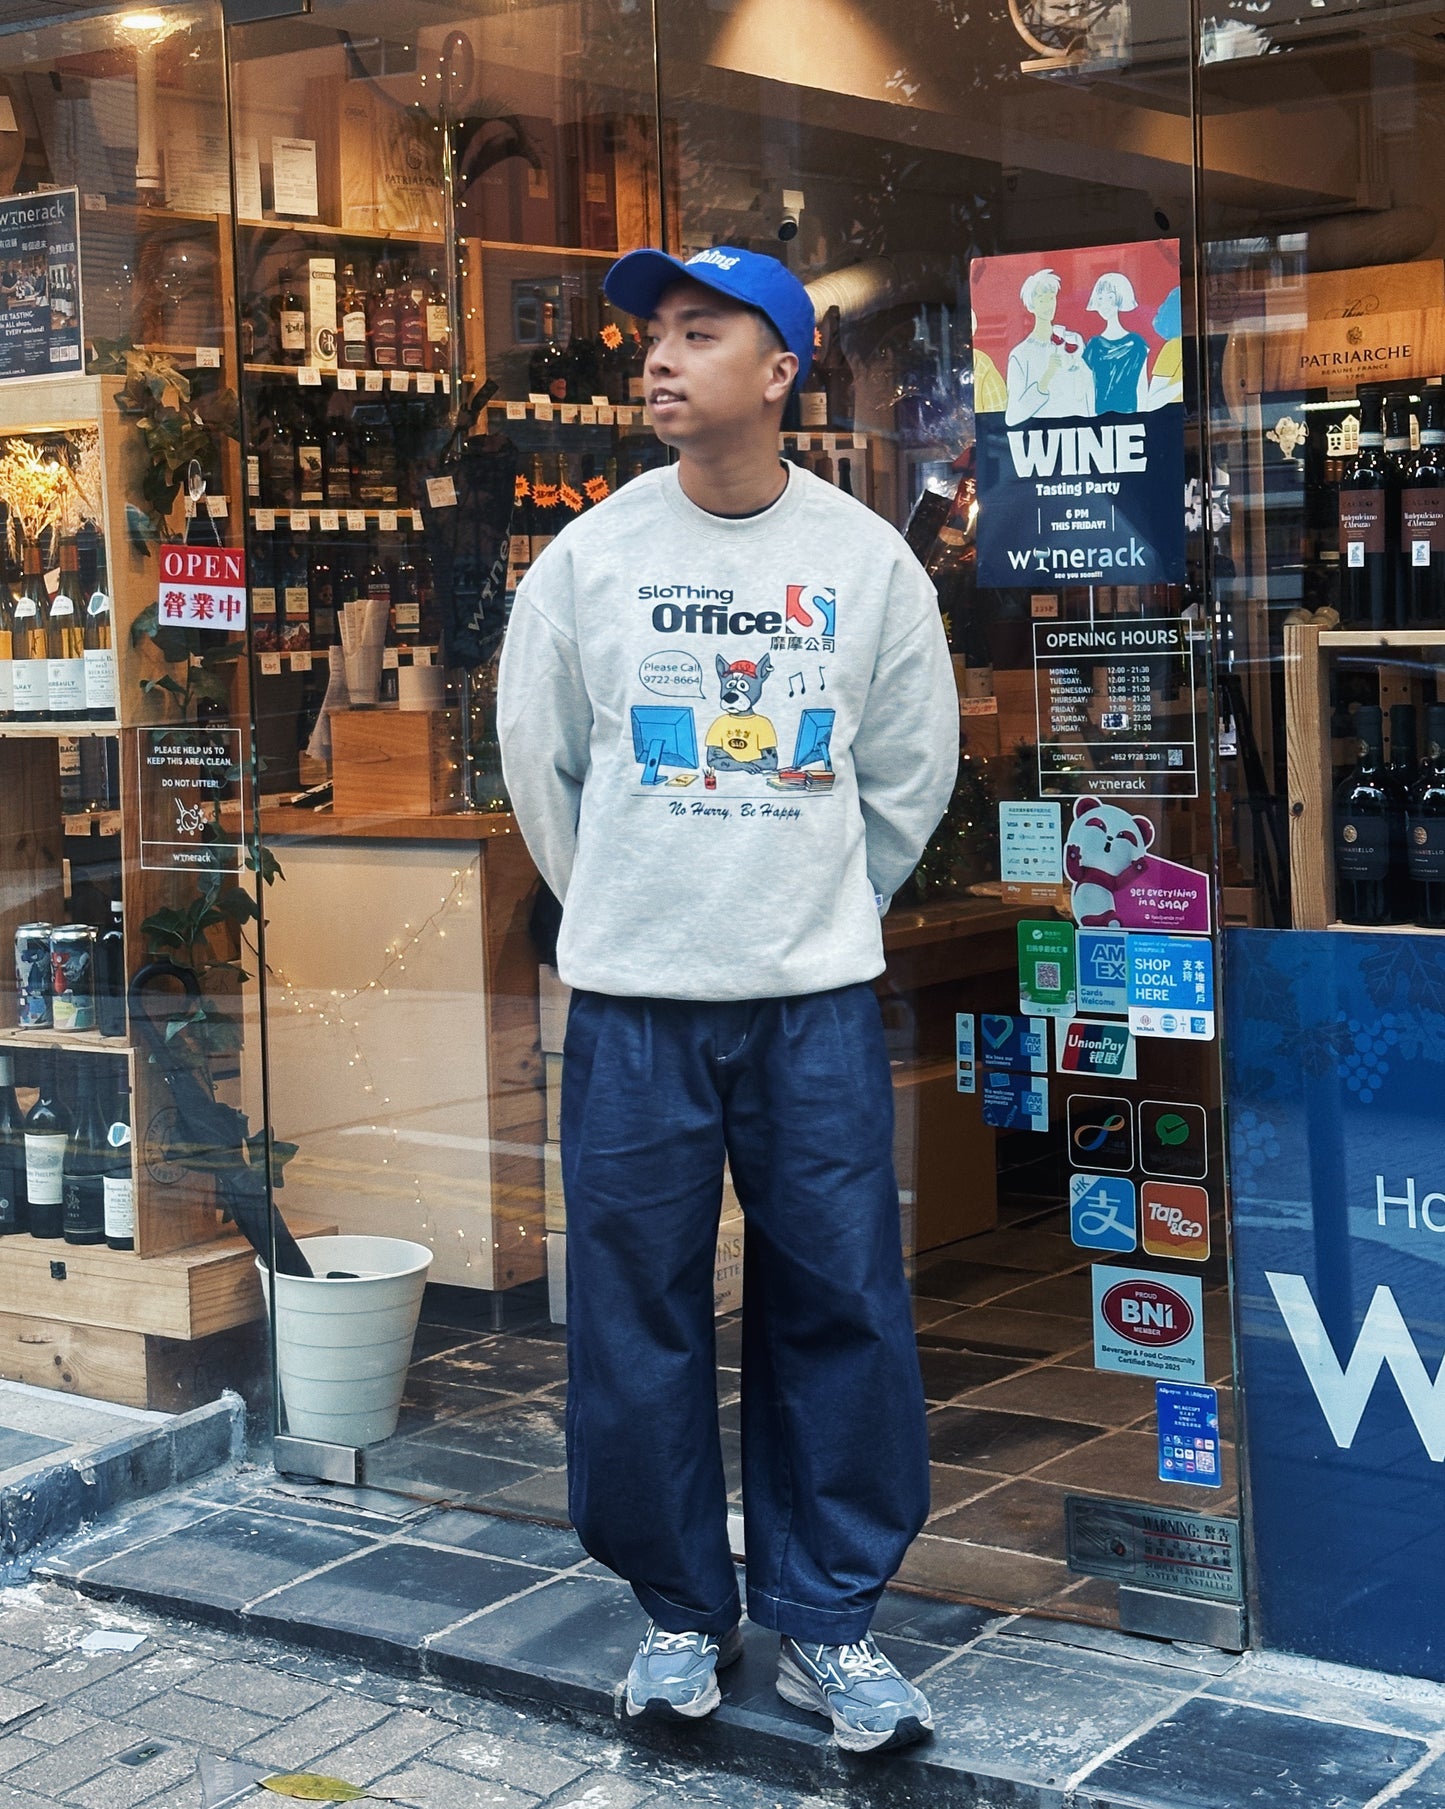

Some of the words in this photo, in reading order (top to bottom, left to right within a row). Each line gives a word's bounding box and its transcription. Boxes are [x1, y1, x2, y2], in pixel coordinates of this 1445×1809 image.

[1300, 345, 1412, 369] PATRIARCHE
[1357, 363, 1389, 372] FRANCE
[1007, 424, 1148, 478] WINE
[1036, 482, 1082, 496] Tasting
[1085, 481, 1120, 495] Party
[1066, 509, 1072, 519] 6
[1074, 508, 1089, 518] PM
[1051, 522, 1070, 531] THIS
[1072, 520, 1106, 530] FRIDAY!
[1007, 537, 1146, 573] winerack
[165, 553, 242, 579] OPEN
[1067, 572, 1079, 580] you
[638, 585, 734, 604] SloThing
[164, 591, 241, 622] 營業中
[651, 603, 782, 636] Office
[1046, 632, 1116, 648] OPENING
[1121, 629, 1178, 645] HOURS
[644, 663, 678, 672] Please
[680, 663, 700, 672] Call
[644, 675, 700, 684] 9722-8664
[154, 747, 181, 755] PLEASE
[183, 747, 202, 755] HELP
[215, 747, 225, 755] TO
[147, 757, 166, 765] KEEP
[184, 758, 205, 766] AREA
[206, 757, 233, 766] CLEAN.
[162, 779, 173, 787] DO
[174, 779, 190, 787] NOT
[1088, 776, 1146, 790] winerack
[668, 801, 687, 816] No
[690, 801, 733, 820] Hurry,
[740, 803, 756, 817] Be
[173, 852, 211, 863] winerack
[1130, 888, 1145, 897] get
[1147, 888, 1197, 900] everything
[1138, 897, 1147, 906] in
[1149, 899, 1156, 907] a
[1157, 899, 1189, 912] snap
[1135, 958, 1171, 971] SHOP
[1135, 973, 1177, 987] LOCAL
[1081, 988, 1103, 997] Cards
[1135, 988, 1170, 1001] HERE
[1080, 996, 1115, 1007] Welcome
[1068, 1034, 1125, 1056] UnionPay
[1072, 1176, 1091, 1197] HK
[1135, 1291, 1158, 1300] PROUD
[1133, 1326, 1161, 1336] MEMBER
[1102, 1344, 1132, 1356] Beverage
[1139, 1350, 1157, 1359] Food
[1157, 1352, 1196, 1365] Community
[1118, 1356, 1146, 1367] Certified
[1146, 1360, 1164, 1370] Shop
[1165, 1363, 1181, 1371] 2025
[1142, 1516, 1200, 1538] WARNING:
[1176, 1565, 1231, 1582] SURVEILLANCE
[1145, 1571, 1179, 1583] SYSTEM
[1184, 1576, 1233, 1592] INSTALLED
